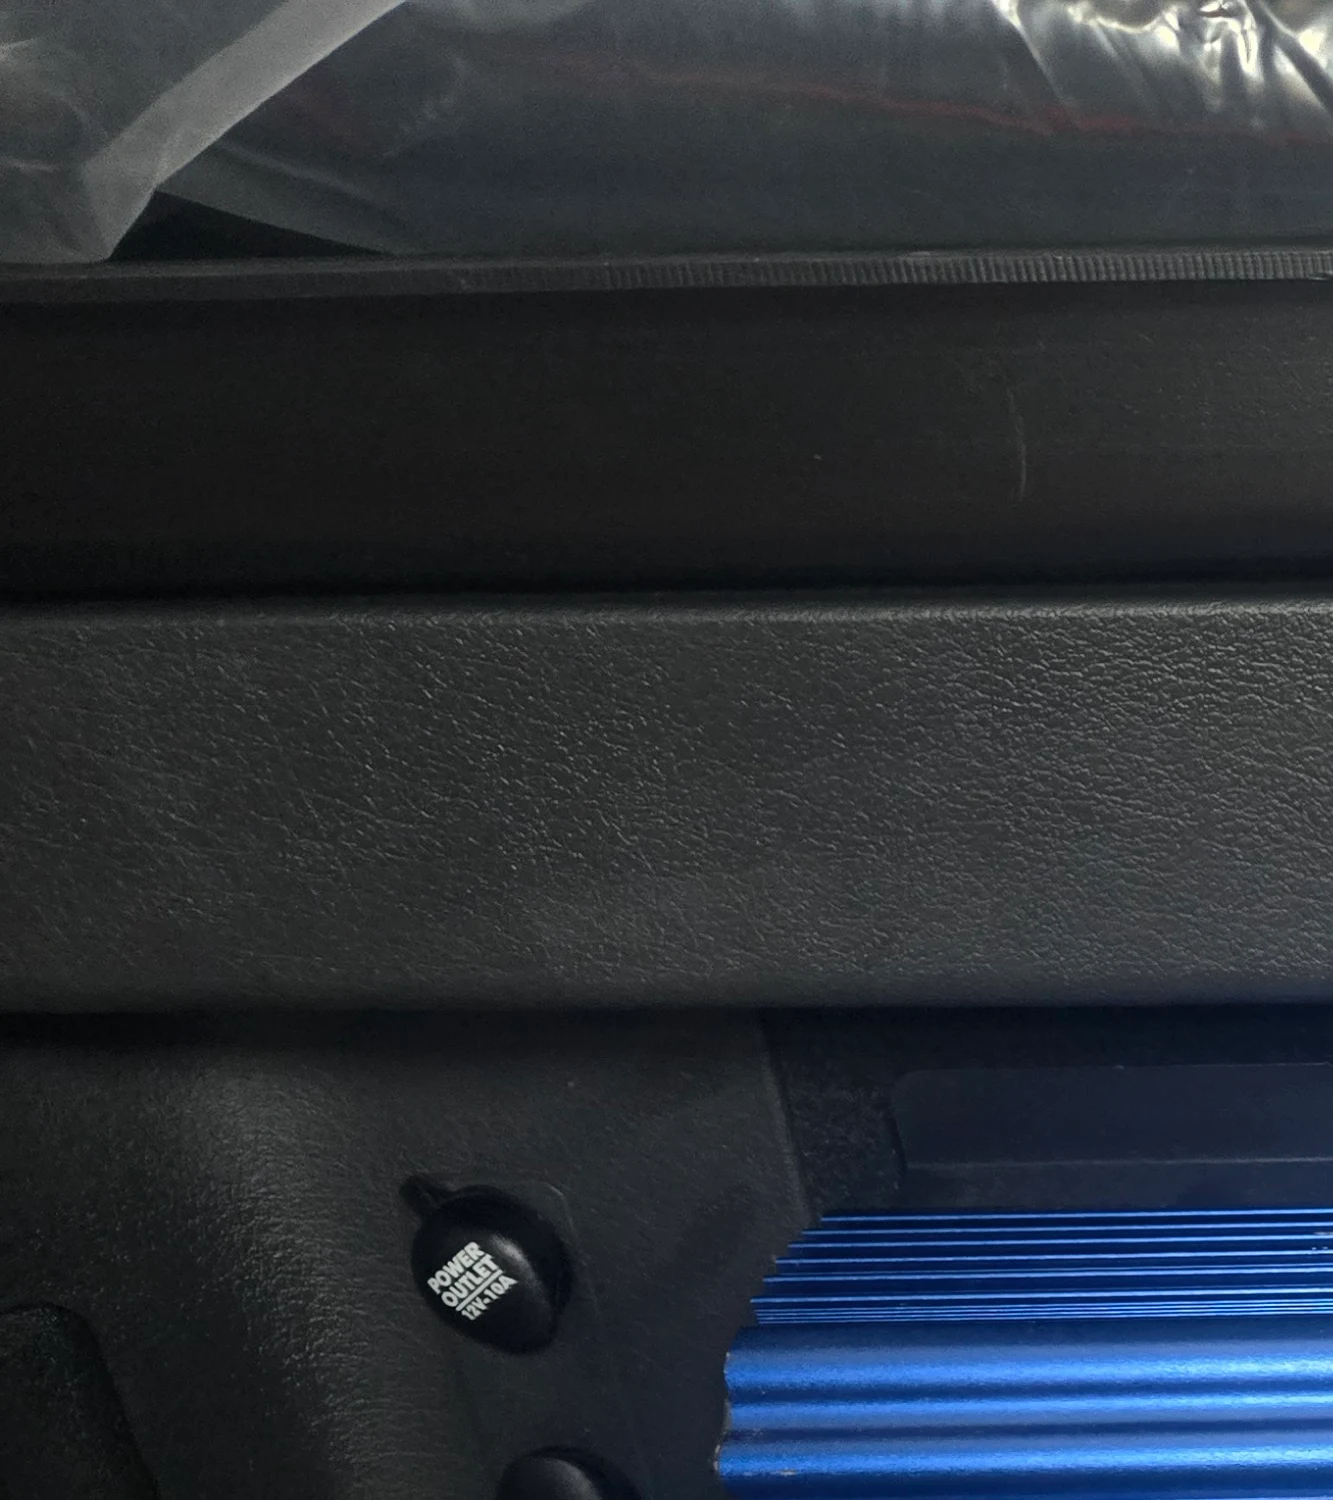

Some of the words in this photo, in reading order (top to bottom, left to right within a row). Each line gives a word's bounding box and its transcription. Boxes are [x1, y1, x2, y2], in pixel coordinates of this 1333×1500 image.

[427, 1241, 485, 1295] POWER
[441, 1253, 499, 1307] OUTLET
[461, 1275, 518, 1320] 12V-10A
